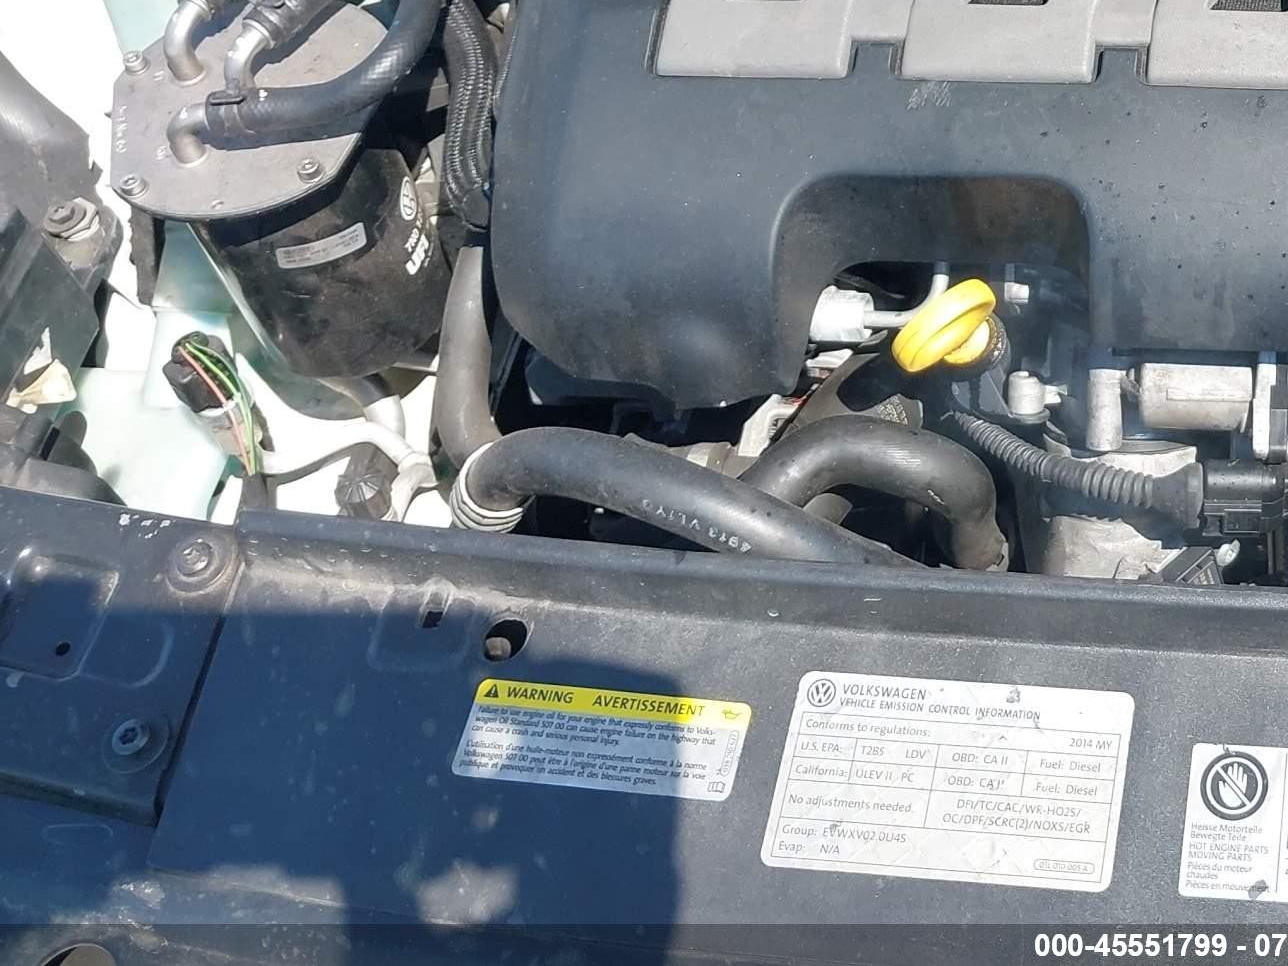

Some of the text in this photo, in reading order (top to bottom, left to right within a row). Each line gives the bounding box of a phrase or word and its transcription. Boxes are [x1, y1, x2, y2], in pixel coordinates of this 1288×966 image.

[843, 684, 926, 699] VOLKSWAGEN
[507, 686, 704, 714] WARNING AVERTISSEMENT
[839, 697, 1040, 719] VEHICLE EMISSION CONTROL INFORMATION
[806, 718, 930, 736] Conforms to regulations:
[671, 733, 700, 745] highway
[1069, 737, 1112, 749] 2014 MY
[800, 741, 842, 752] U.S. EPA:
[905, 749, 926, 758] LDV
[951, 752, 978, 762] OBD:
[983, 754, 997, 763] CA
[795, 764, 847, 776] California:
[1039, 758, 1100, 772] Fuel: Diesel
[855, 769, 882, 779] ULEV
[900, 772, 914, 782] PC
[947, 775, 974, 786] OBD:
[979, 777, 995, 788] CA
[1035, 781, 1097, 795] Fuel: Diesel
[788, 794, 803, 803] No
[806, 796, 869, 809] adjustments
[782, 824, 816, 837] Group:
[778, 840, 839, 854] Evap: N/A
[1188, 841, 1268, 854] HOT ENGINE PARTS
[1188, 850, 1224, 859] MOVING
